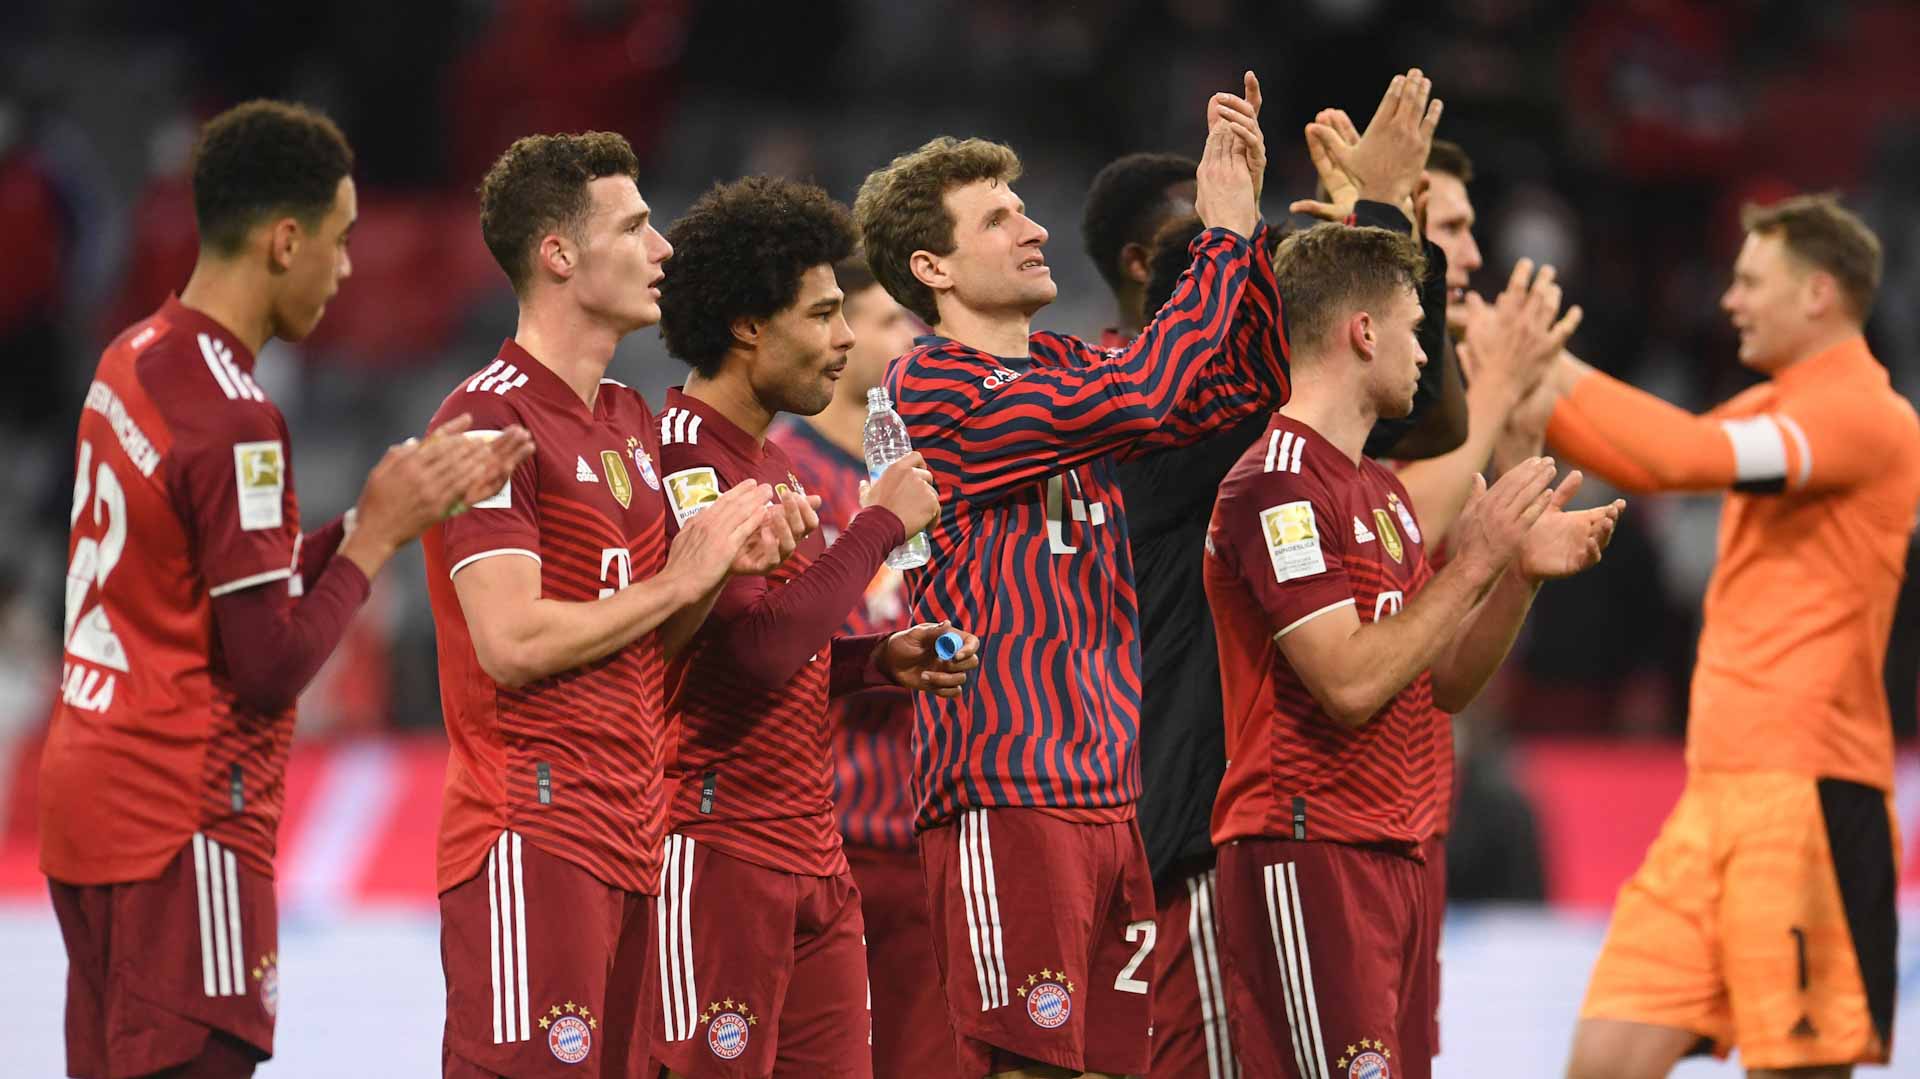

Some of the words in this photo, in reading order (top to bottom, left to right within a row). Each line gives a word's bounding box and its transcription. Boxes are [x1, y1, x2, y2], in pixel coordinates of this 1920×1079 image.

[1113, 920, 1157, 995] 2
[1789, 925, 1808, 990] 1
[1030, 992, 1041, 1004] FC
[1037, 985, 1067, 1002] BAYERN
[711, 1021, 721, 1033] FC
[720, 1015, 746, 1033] BAYERN
[1031, 1008, 1068, 1026] MÜNCHEN
[551, 1022, 562, 1037] FC
[560, 1018, 588, 1038] BAYERN
[552, 1043, 588, 1061] MÜNCHEN
[711, 1039, 746, 1057] MÜNCHEN
